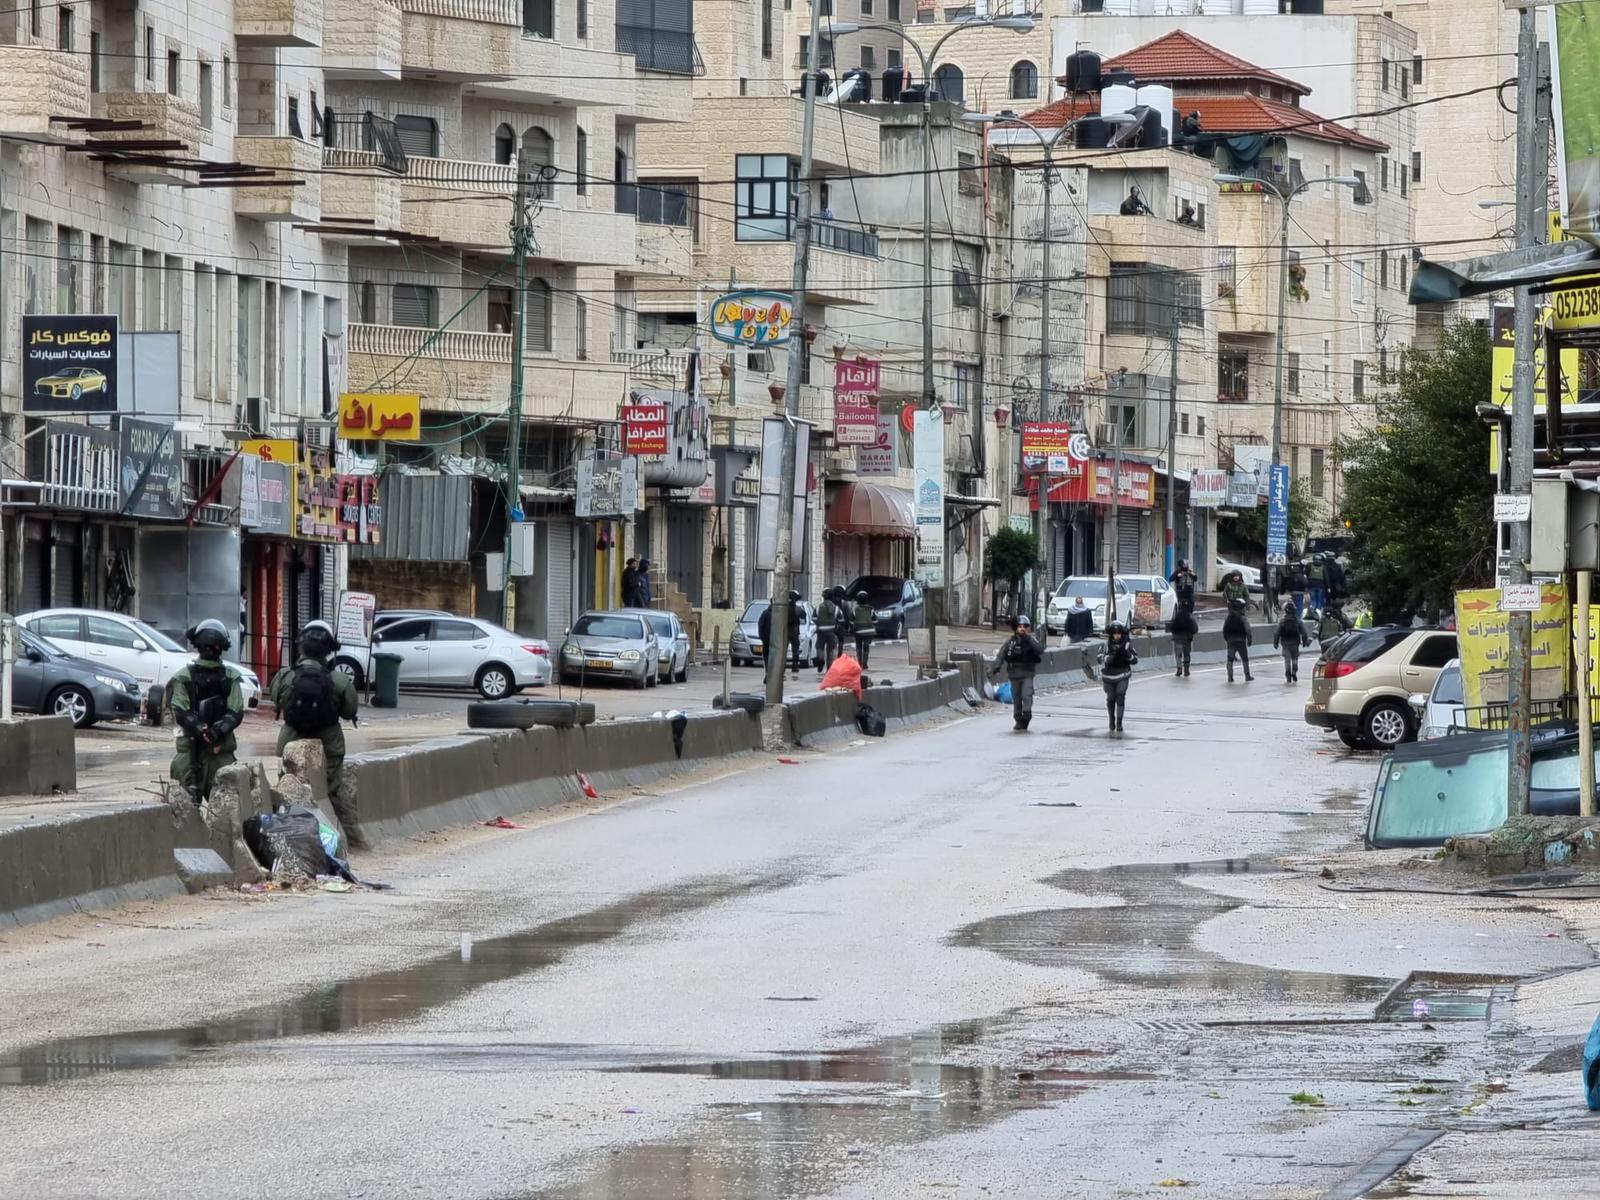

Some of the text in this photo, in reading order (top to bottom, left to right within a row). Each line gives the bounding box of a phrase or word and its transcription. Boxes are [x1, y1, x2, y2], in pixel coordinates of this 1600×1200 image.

[30, 330, 111, 345] فوكس كار
[734, 320, 780, 342] Toys
[30, 350, 111, 360] لكماليات السيارات
[343, 399, 413, 436] صراف
[838, 412, 876, 421] Balloons
